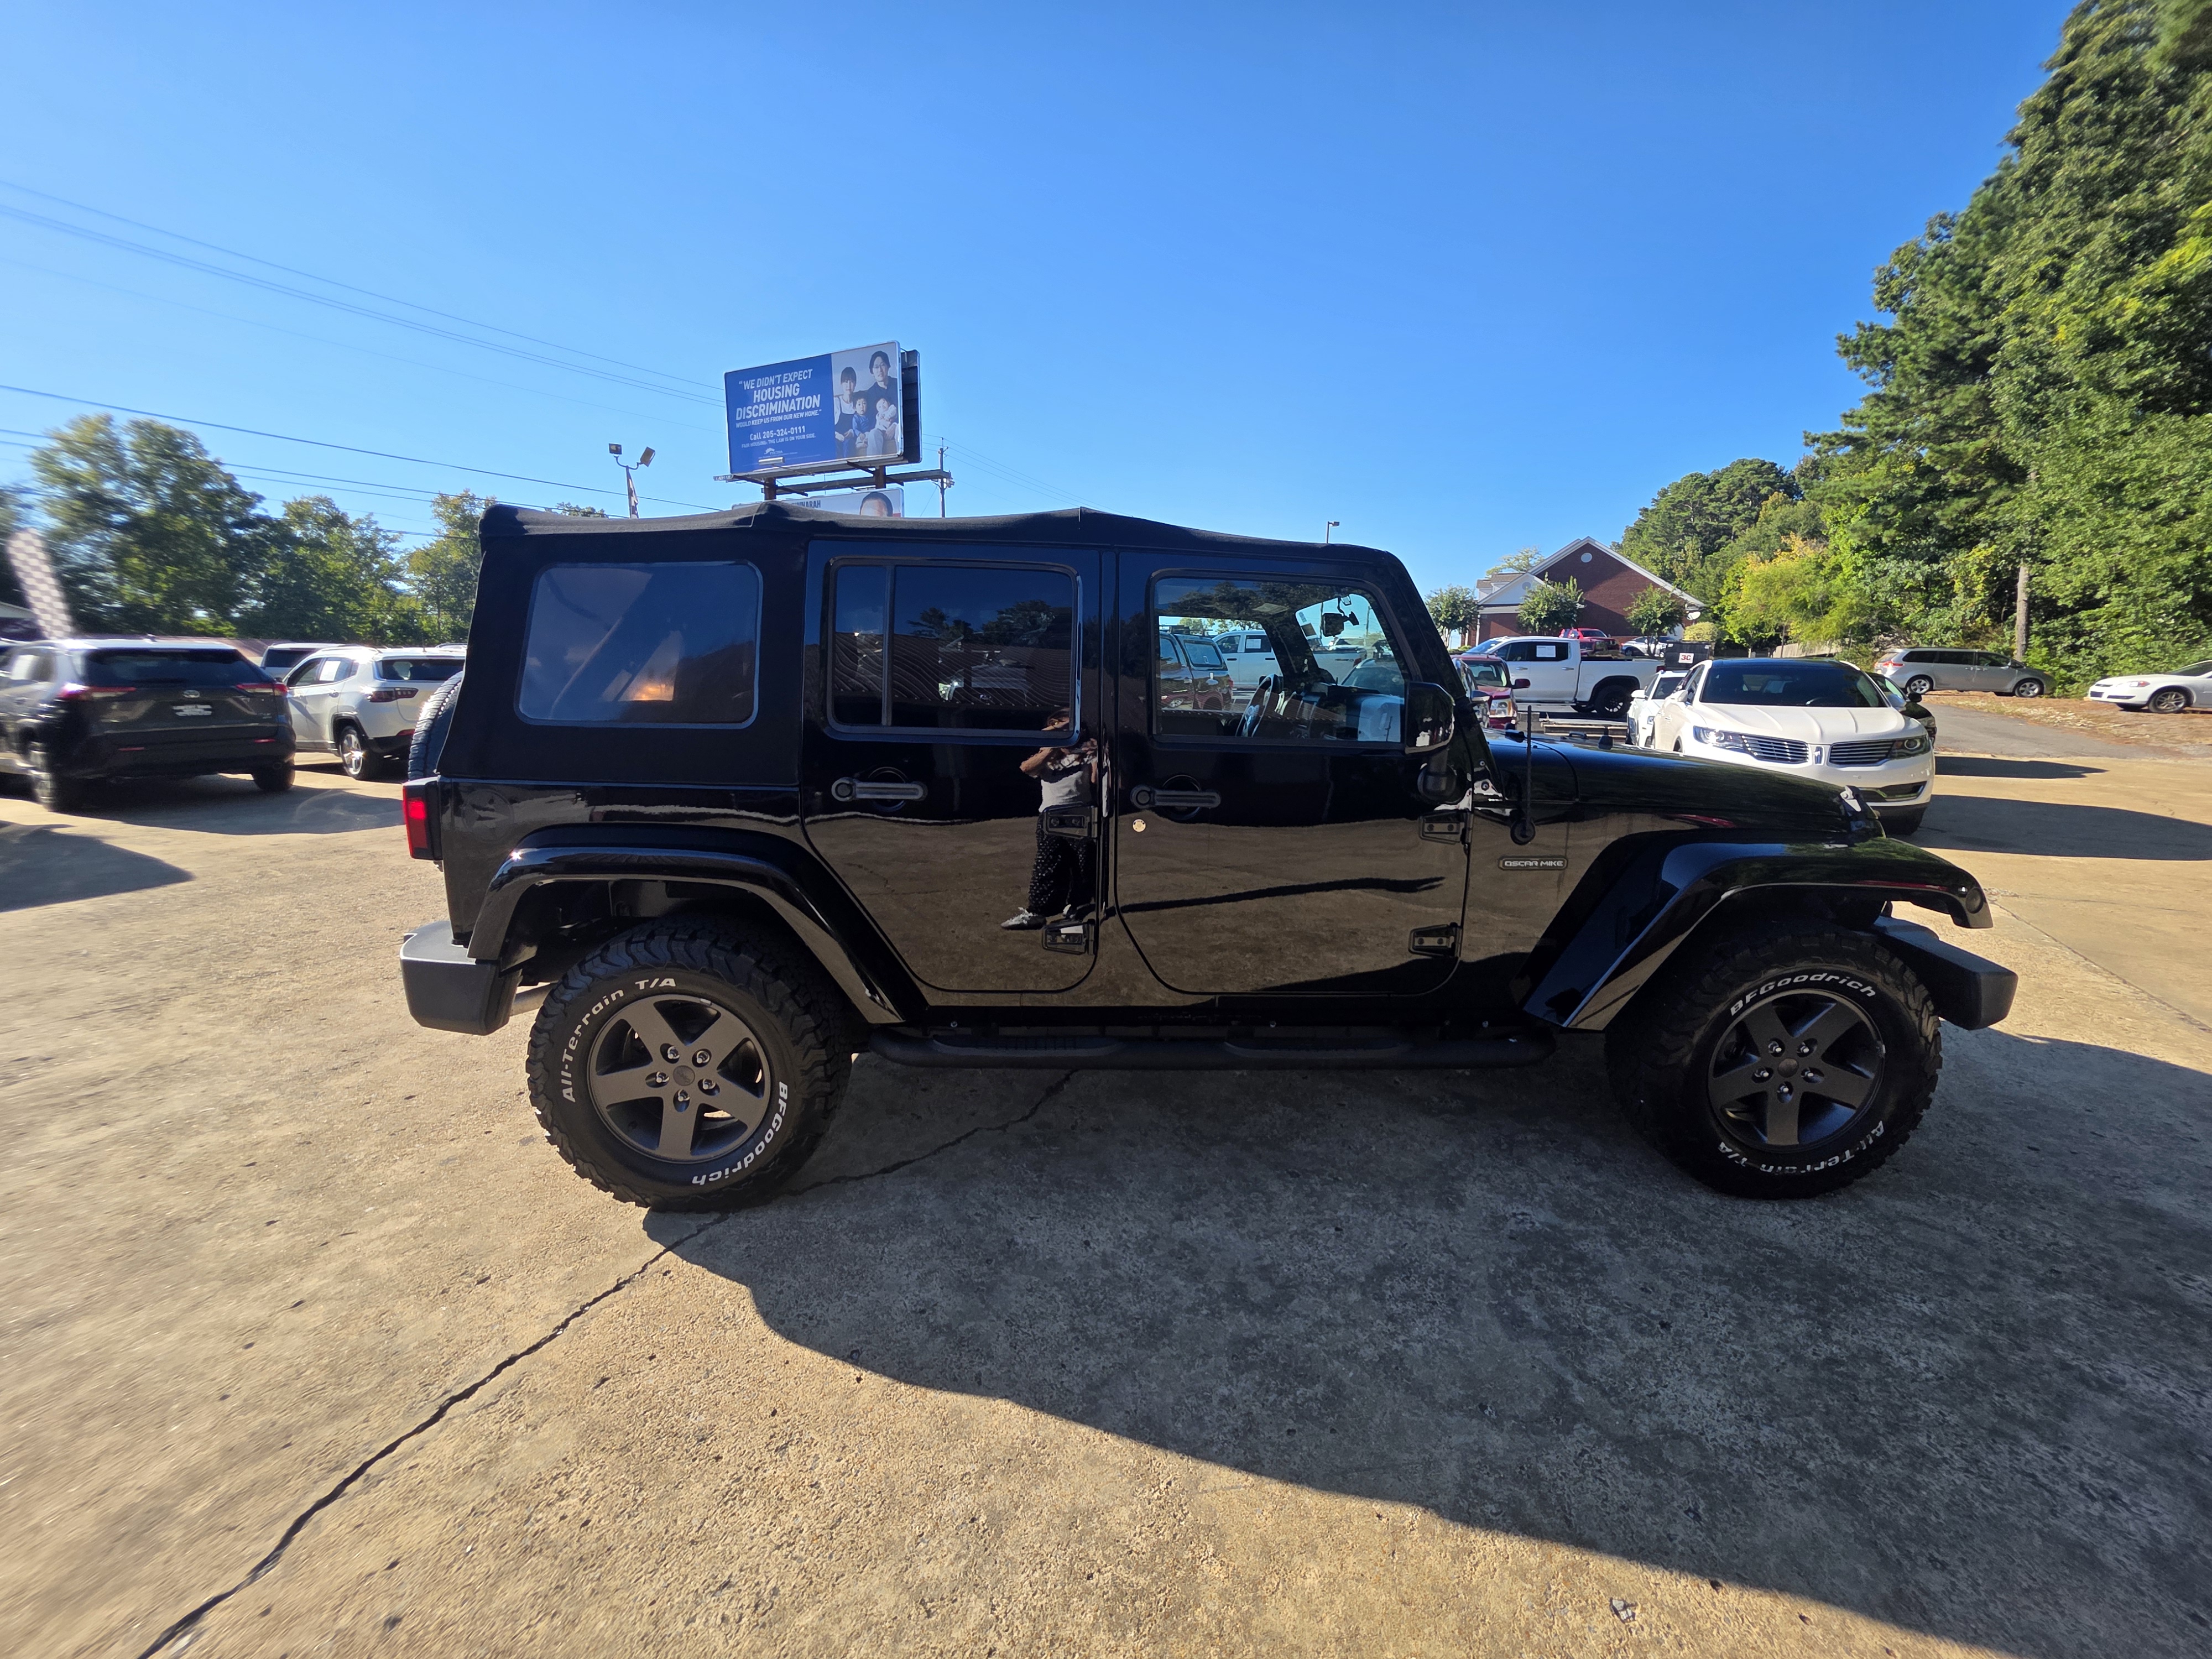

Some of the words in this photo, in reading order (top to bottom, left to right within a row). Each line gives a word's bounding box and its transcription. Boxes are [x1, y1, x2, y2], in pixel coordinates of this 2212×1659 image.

[753, 383, 800, 403] HOUSING
[757, 374, 781, 388] DIDN'T
[782, 369, 813, 383] EXPECT
[735, 394, 821, 420] DISCRIMINATION
[749, 432, 761, 441] Call
[763, 425, 805, 439] 205-324-0111
[1730, 973, 1876, 1016] BFGoodrich
[562, 989, 624, 1103] All-Terrain
[635, 978, 676, 989] T/A
[691, 1081, 788, 1185] BFGoodrich
[1760, 1120, 1885, 1174] All-Terrain
